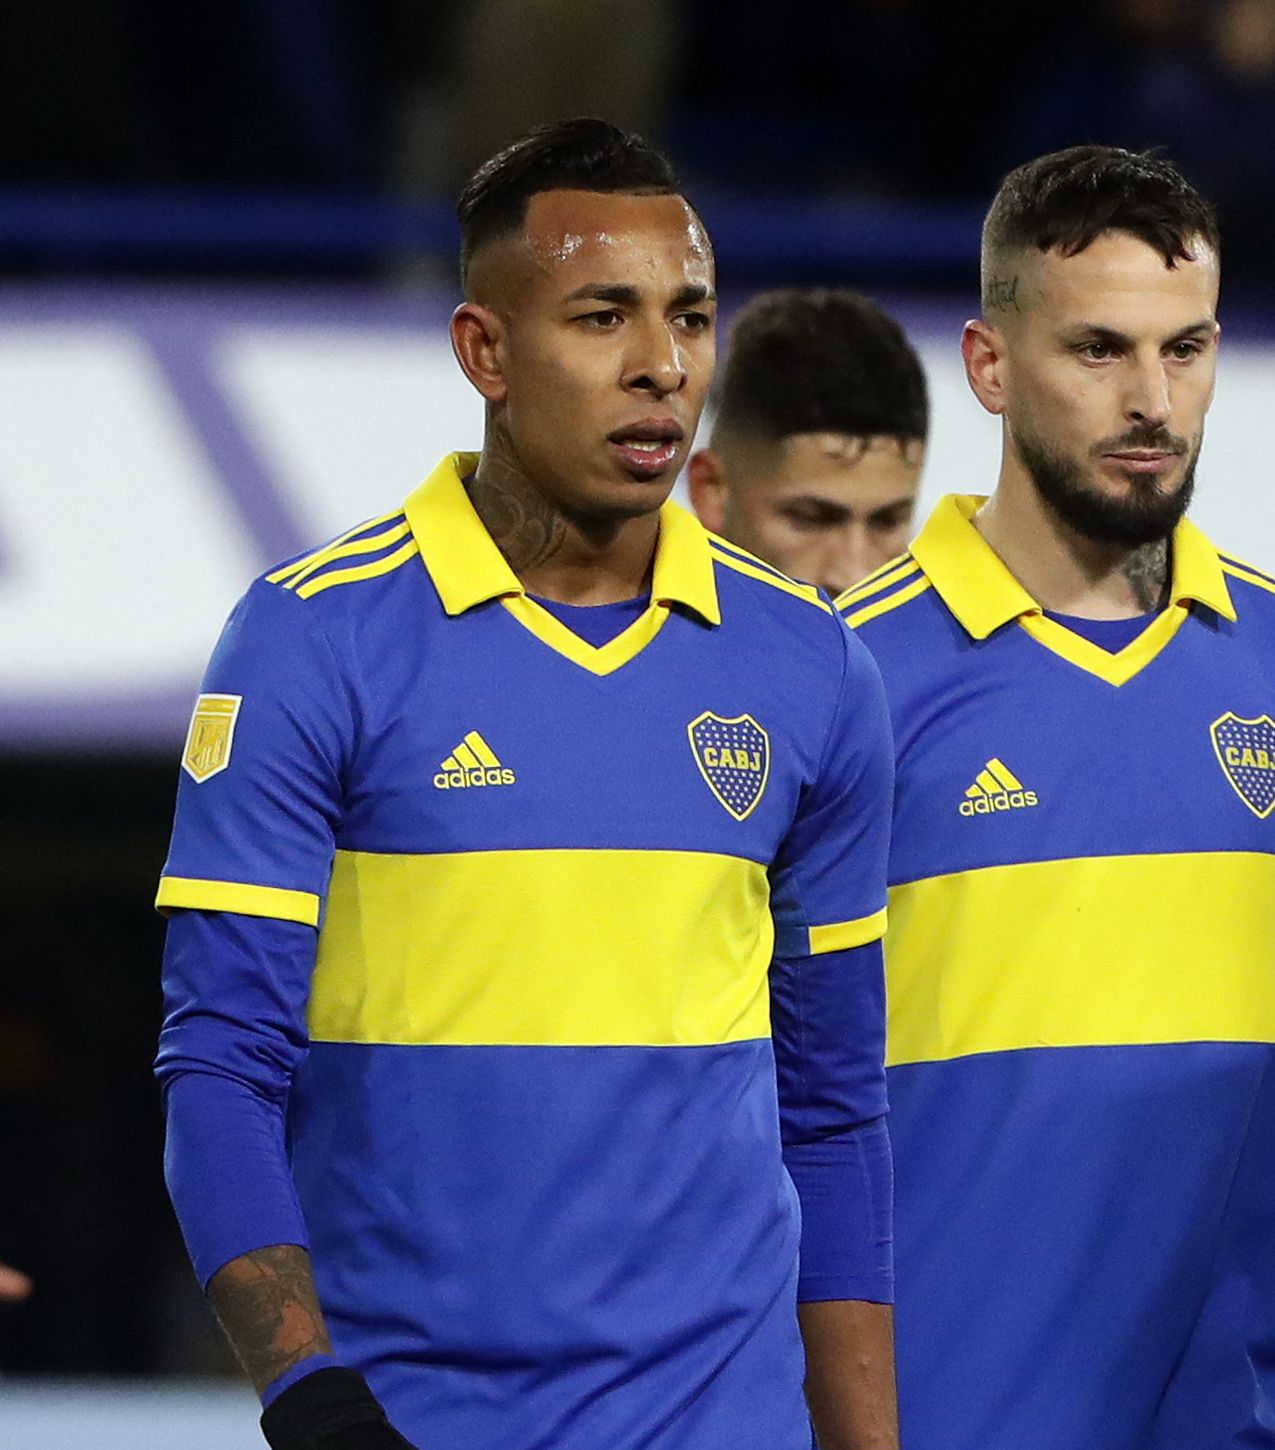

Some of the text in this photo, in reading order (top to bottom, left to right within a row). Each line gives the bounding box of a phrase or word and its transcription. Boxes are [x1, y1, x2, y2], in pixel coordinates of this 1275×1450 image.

[704, 747, 760, 771] CABJ
[434, 767, 515, 789] adidas
[959, 787, 1038, 816] adidas
